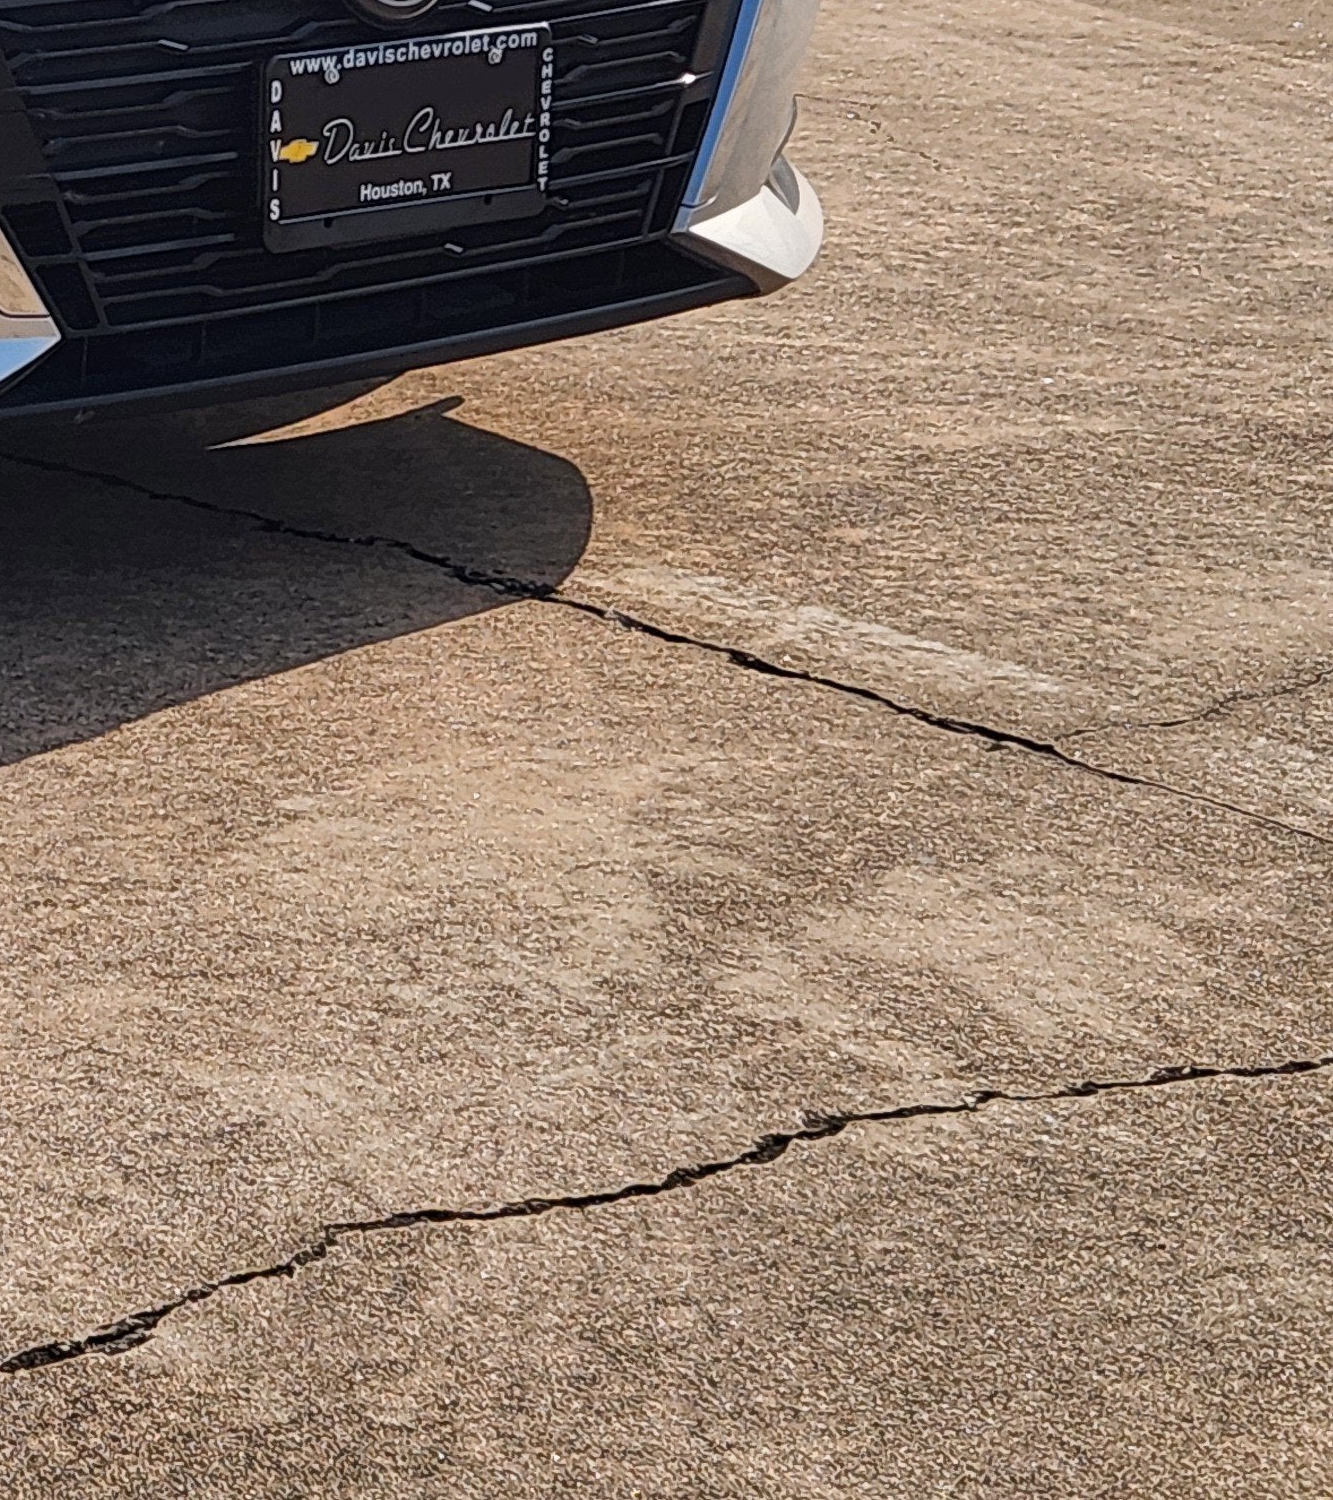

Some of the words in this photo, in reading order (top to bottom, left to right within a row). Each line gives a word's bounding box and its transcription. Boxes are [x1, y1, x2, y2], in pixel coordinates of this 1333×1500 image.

[289, 31, 538, 76] www.davischevrolet.com
[322, 117, 403, 165] Davis
[402, 106, 537, 153] Chevrolet
[537, 47, 553, 191] CHEVROLET
[269, 79, 282, 222] DAVIS
[359, 178, 428, 202] Houston,
[430, 172, 453, 191] TX
